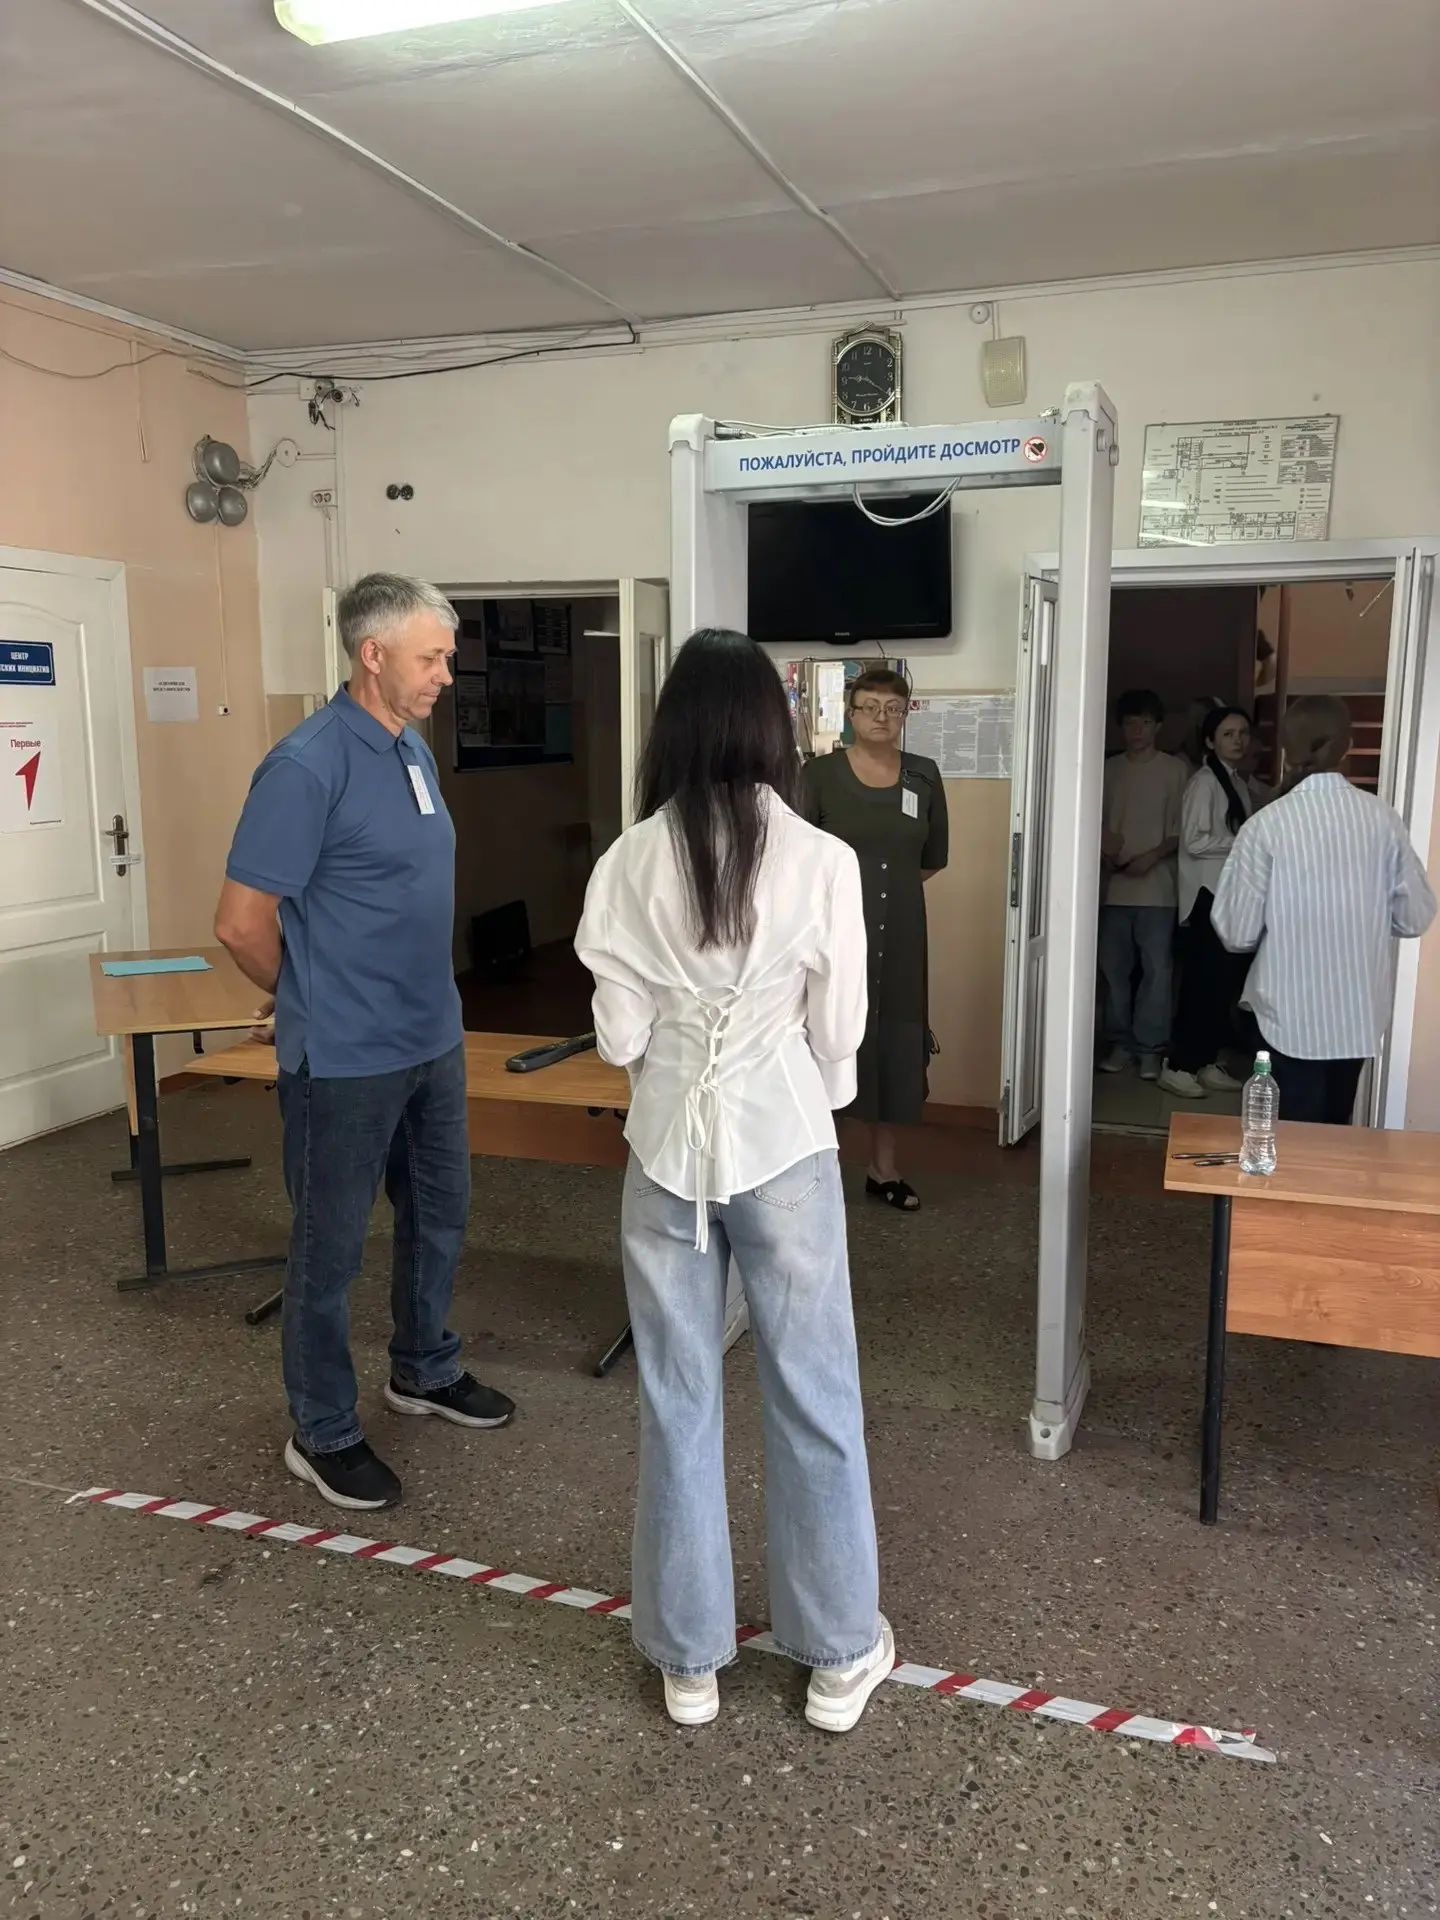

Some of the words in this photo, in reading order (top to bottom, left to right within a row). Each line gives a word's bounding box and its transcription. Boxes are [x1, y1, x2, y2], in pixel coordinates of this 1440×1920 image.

[863, 345, 872, 355] 12
[887, 358, 893, 368] 2
[841, 376, 848, 385] 9
[887, 372, 893, 381] 3
[842, 391, 848, 400] 8
[851, 400, 857, 409] 7
[863, 402, 870, 411] 6
[876, 398, 883, 408] 5
[739, 449, 847, 472] ПОЖАЛУЙСТА,
[851, 444, 936, 466] ПРОЙДИТЕ
[939, 438, 1021, 461] ДОСМОТР
[10, 652, 29, 660] ЦЕНТР
[17, 664, 50, 673] ИНИЦИАТИВ
[10, 739, 41, 750] Первые
